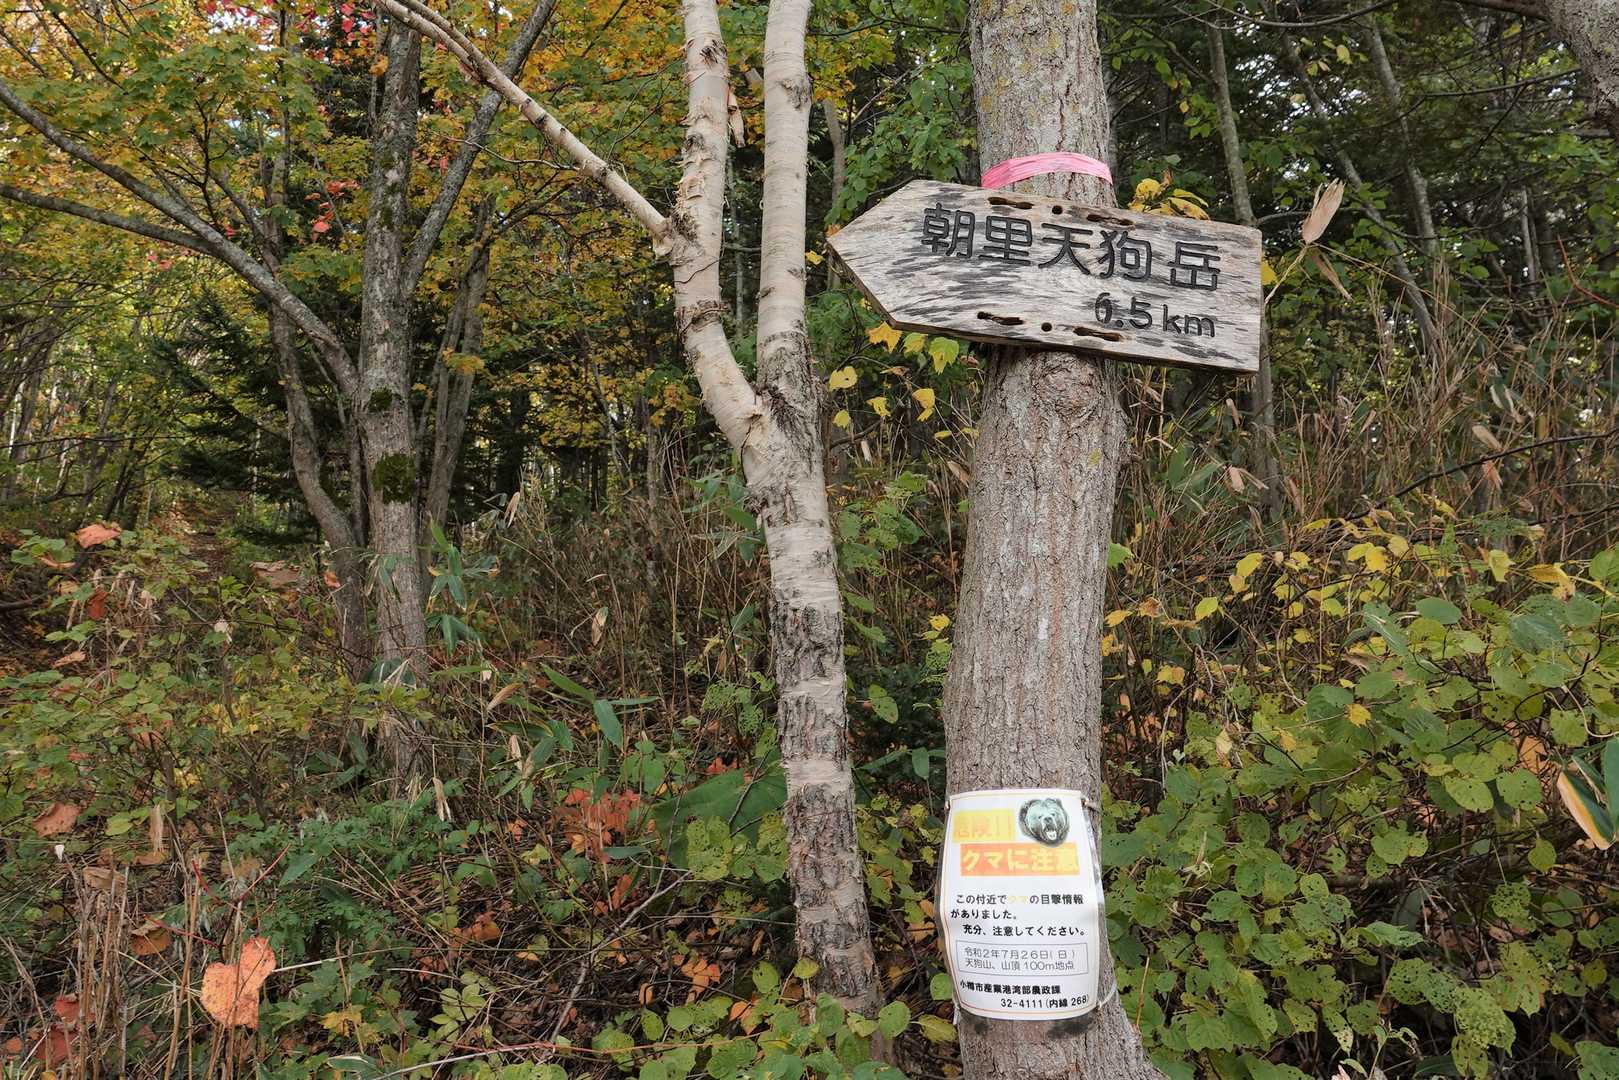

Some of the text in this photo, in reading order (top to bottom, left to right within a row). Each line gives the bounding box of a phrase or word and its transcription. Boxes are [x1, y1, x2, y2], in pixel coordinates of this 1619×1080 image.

[920, 203, 1221, 290] 朝里天狗岳
[1095, 292, 1216, 337] 6.5 km
[956, 894, 1084, 905] この付近での目撃情報
[951, 908, 1017, 920] がありました。
[963, 924, 1085, 936] 充分、注意してください。
